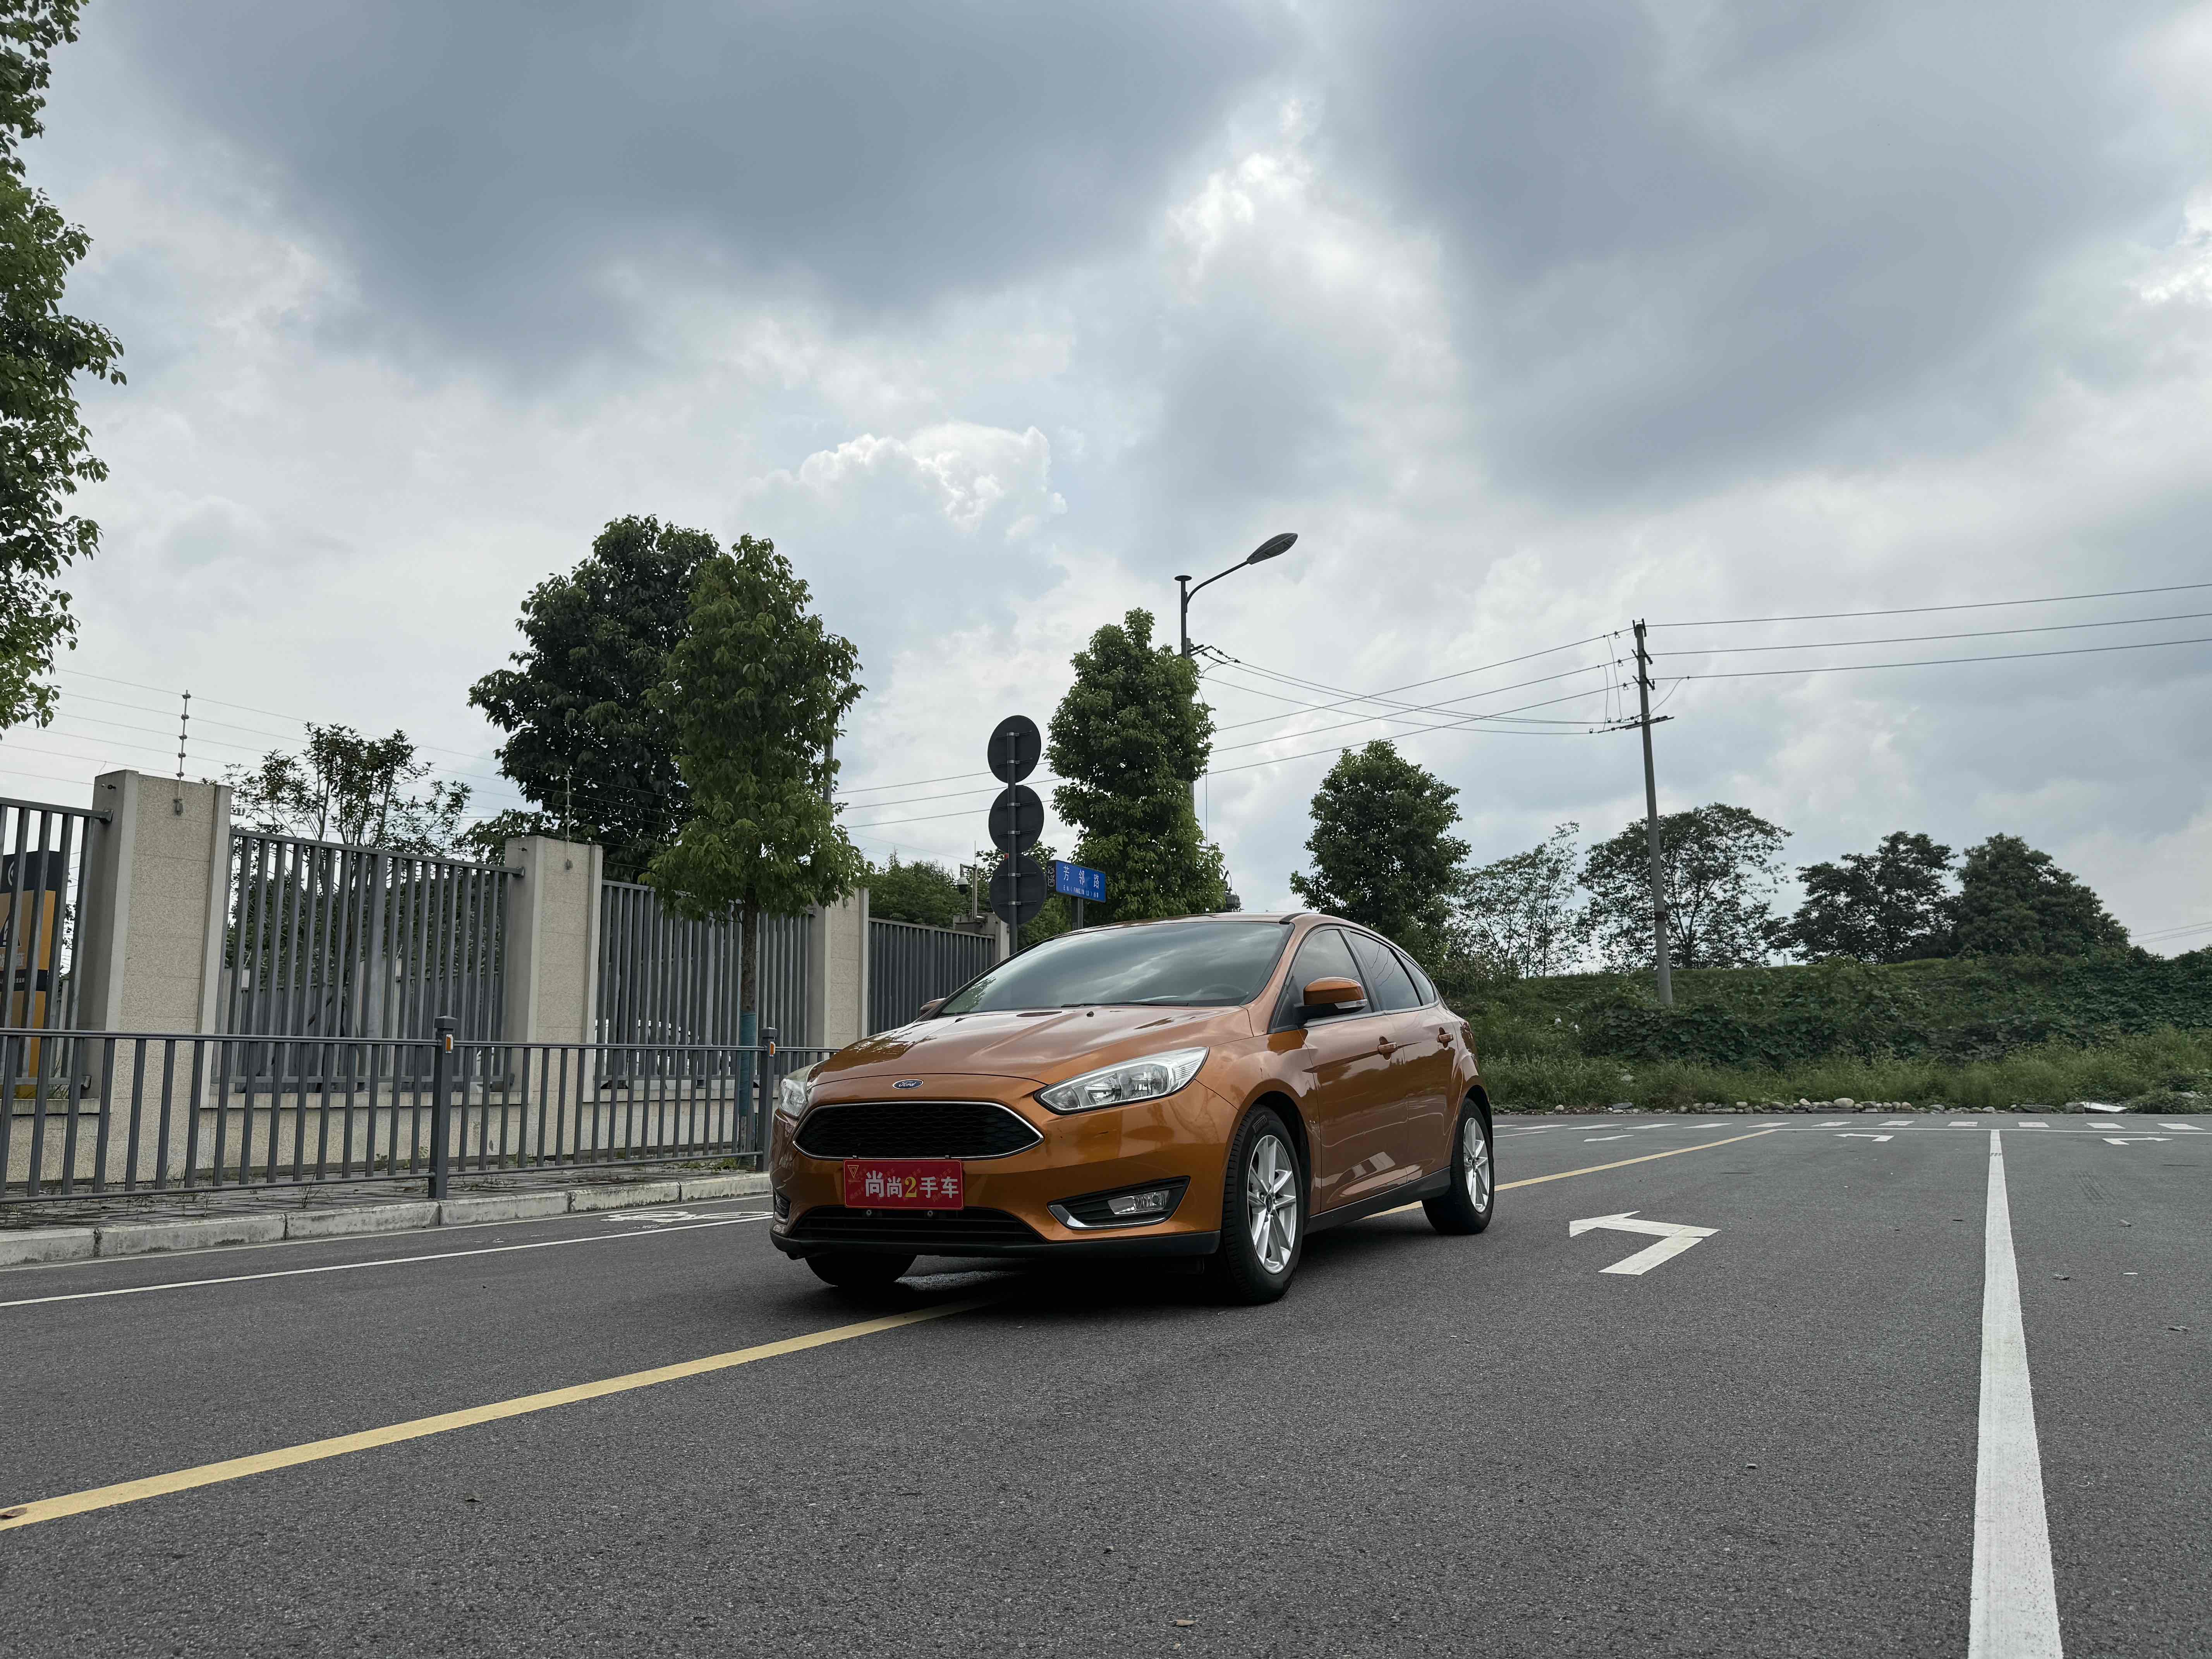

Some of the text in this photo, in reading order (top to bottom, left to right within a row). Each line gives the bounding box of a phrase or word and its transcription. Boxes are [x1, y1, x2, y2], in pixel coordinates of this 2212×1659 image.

[1063, 866, 1099, 889] 芳邻路
[865, 1170, 959, 1198] 尚尚2手车
